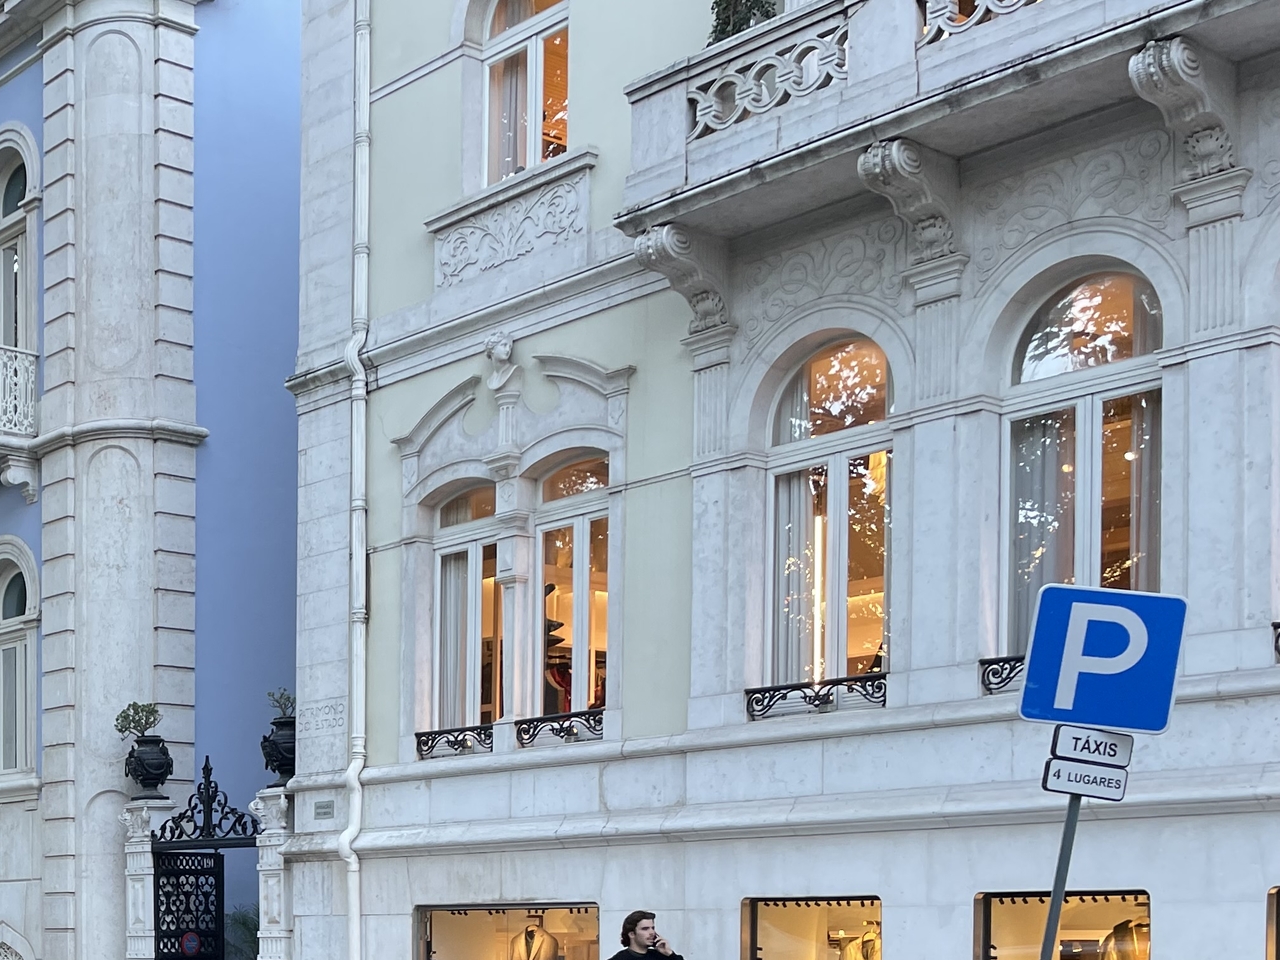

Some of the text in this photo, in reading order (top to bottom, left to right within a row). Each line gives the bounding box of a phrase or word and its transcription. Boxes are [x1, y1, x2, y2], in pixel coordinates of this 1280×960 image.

[1053, 601, 1149, 711] P
[315, 717, 345, 731] ESTADO
[1072, 735, 1119, 758] TÁXIS
[1052, 768, 1122, 790] 4 LUGARES
